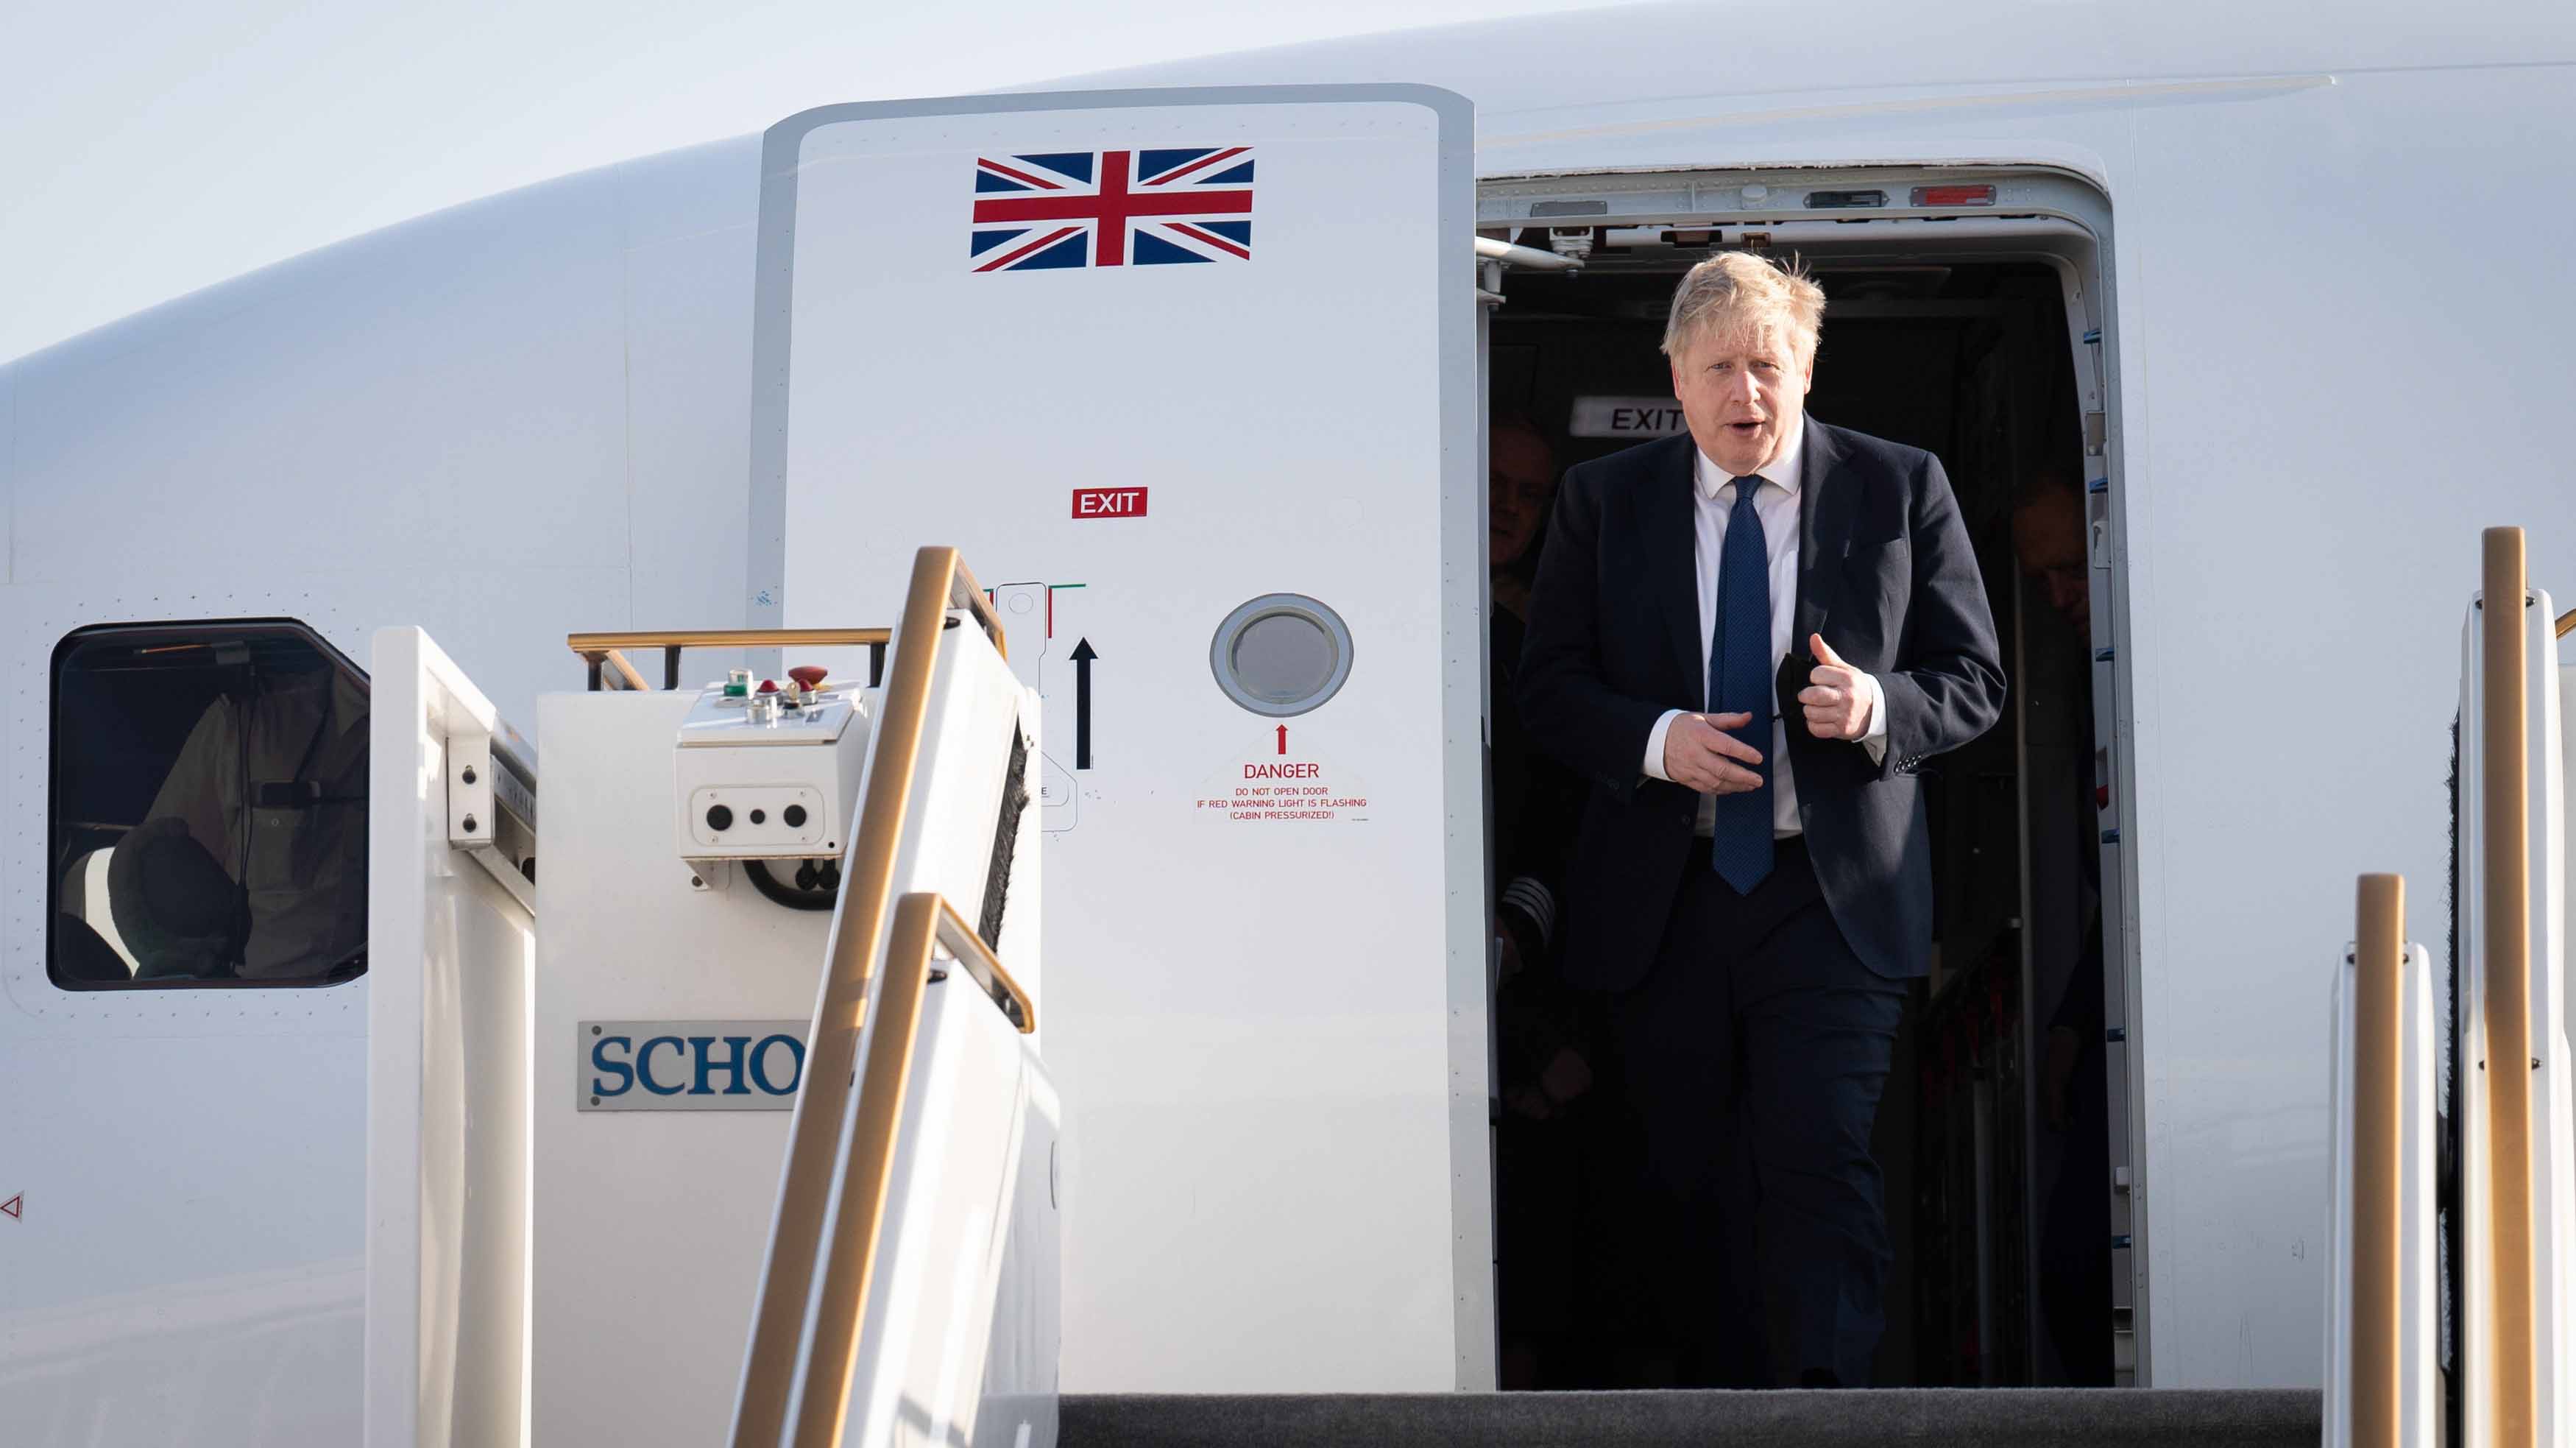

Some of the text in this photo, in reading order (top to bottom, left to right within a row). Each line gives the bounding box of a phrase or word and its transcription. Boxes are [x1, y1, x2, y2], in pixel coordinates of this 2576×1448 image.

[1611, 409, 1683, 430] EXIT
[1080, 492, 1139, 513] EXIT
[1245, 763, 1319, 778] DANGER
[1236, 787, 1328, 796] DO NOT OPEN DOOR
[1232, 799, 1275, 808] WARNING
[1278, 799, 1304, 808] LIGHT
[1308, 799, 1317, 808] IS
[1320, 799, 1367, 807] FLASHING
[1230, 811, 1334, 820] (CABIN PRESSURIZED!)
